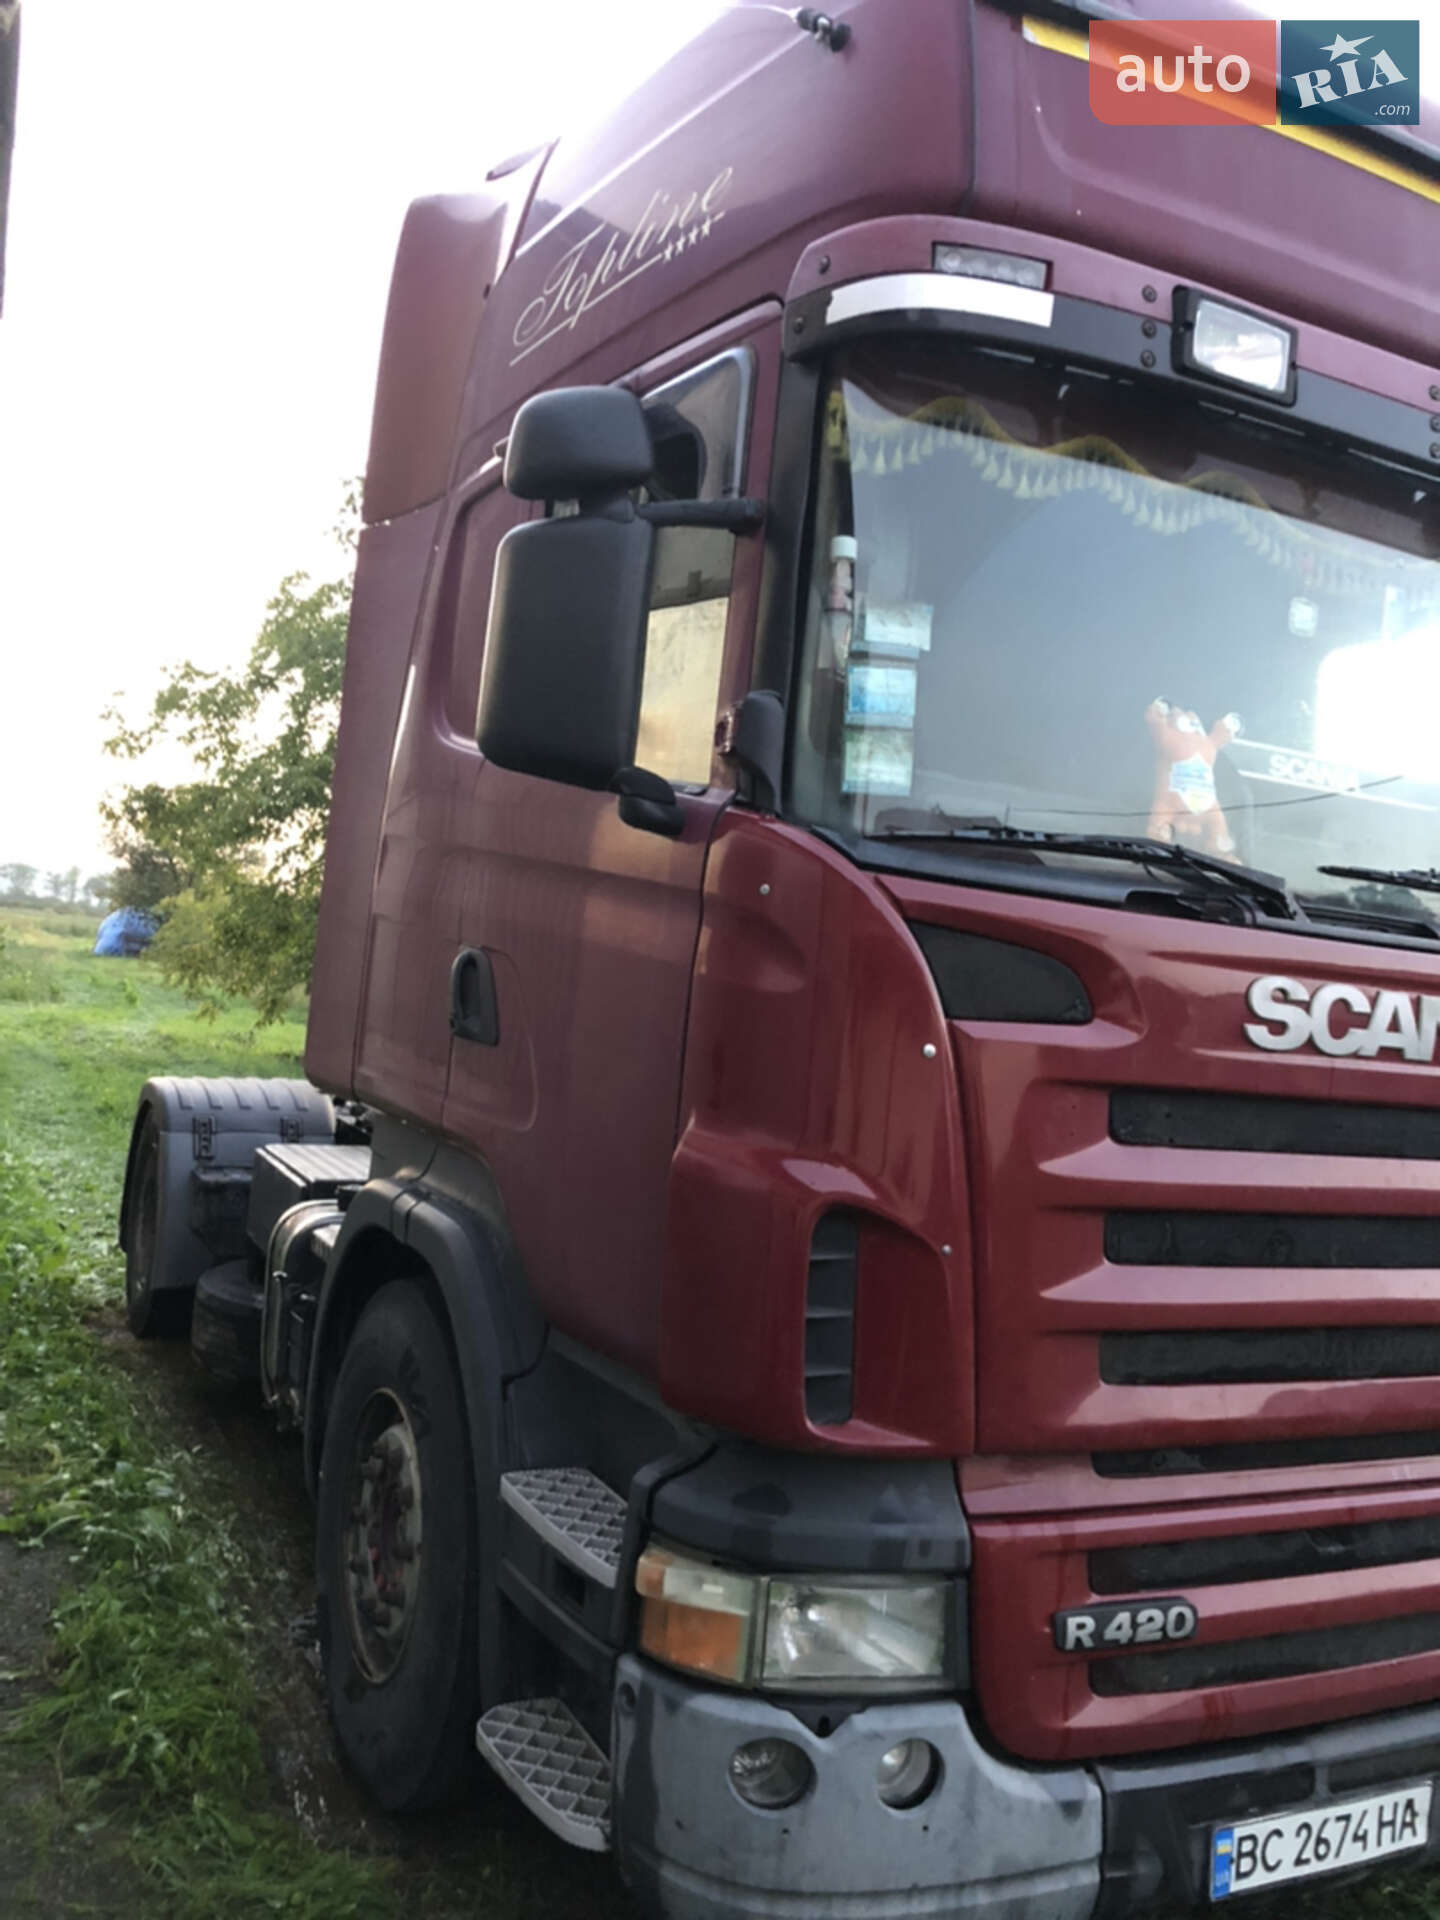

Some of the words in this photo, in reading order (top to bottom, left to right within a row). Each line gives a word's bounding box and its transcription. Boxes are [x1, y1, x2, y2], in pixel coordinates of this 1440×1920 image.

[512, 167, 733, 347] Topline
[1064, 1615, 1096, 1650] R
[1103, 1605, 1195, 1644] 420
[1235, 1828, 1284, 1881] BC
[1294, 1809, 1368, 1868] 2674
[1376, 1798, 1419, 1848] HA
